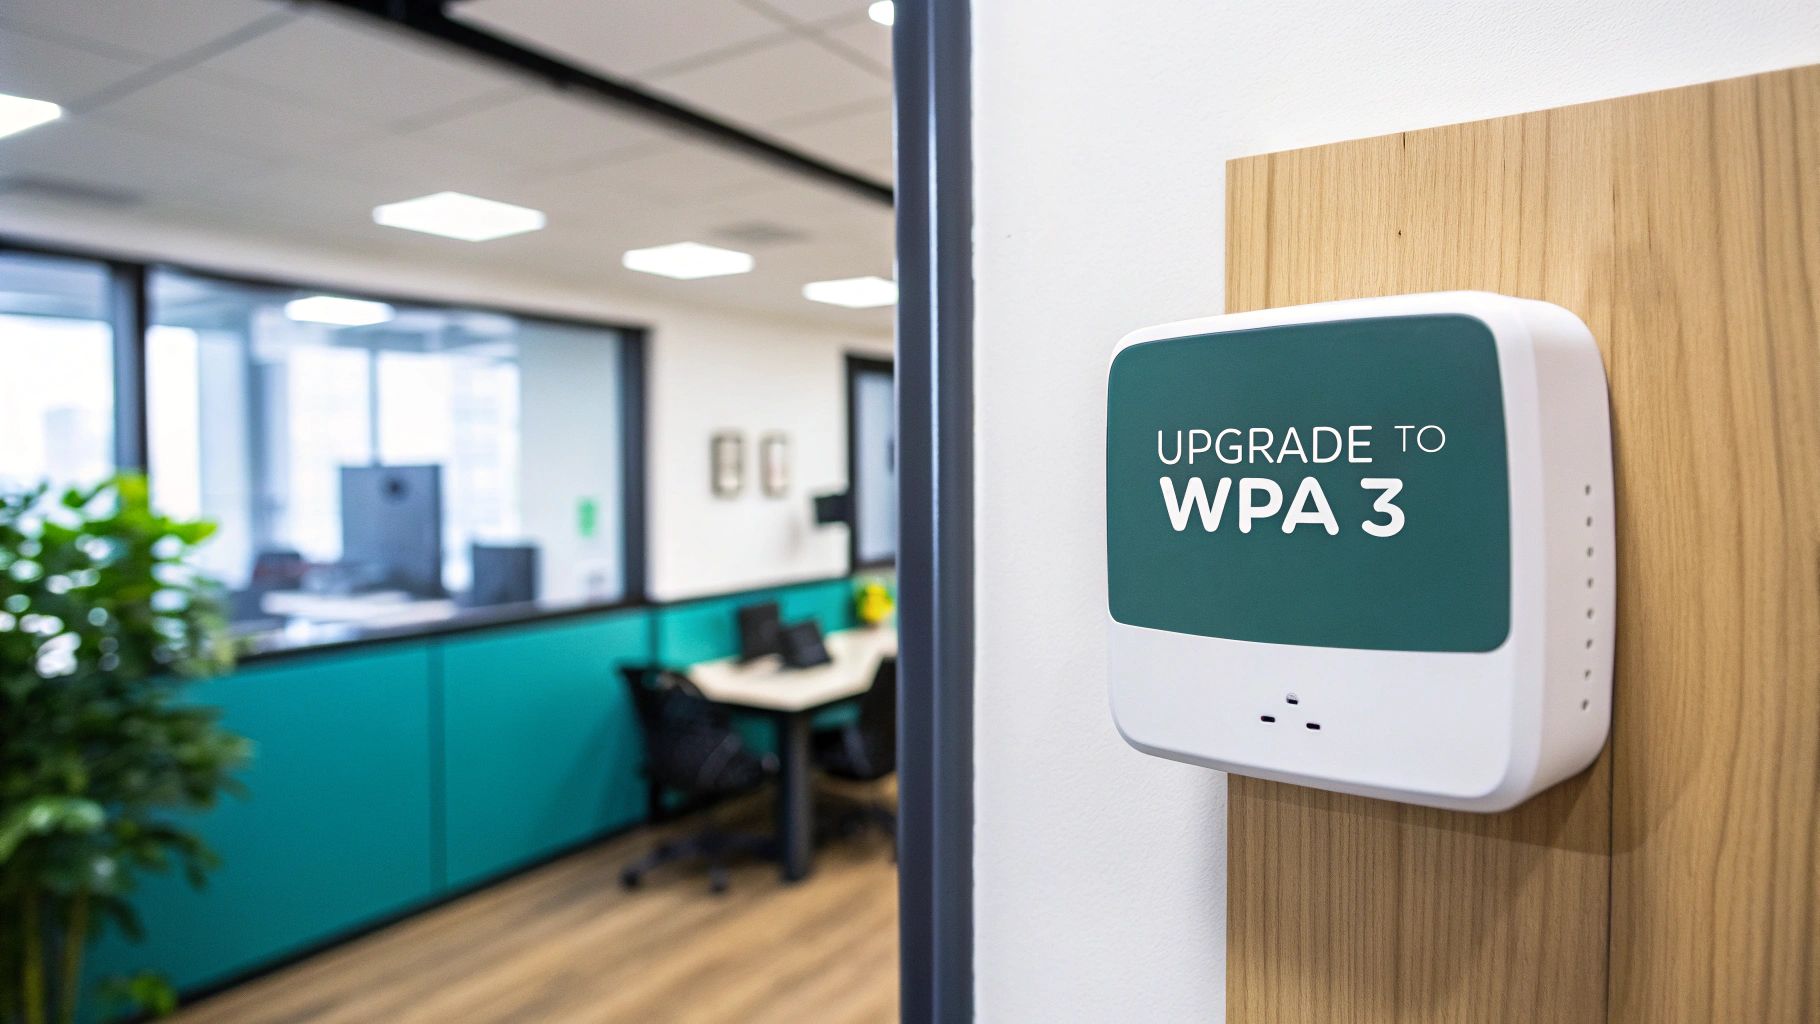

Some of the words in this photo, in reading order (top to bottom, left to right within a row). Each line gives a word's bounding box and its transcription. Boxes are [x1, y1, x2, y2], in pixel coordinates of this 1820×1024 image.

[1157, 425, 1373, 465] UPGRADE
[1394, 424, 1446, 453] TO
[1160, 476, 1340, 536] WPA
[1361, 477, 1406, 538] 3
